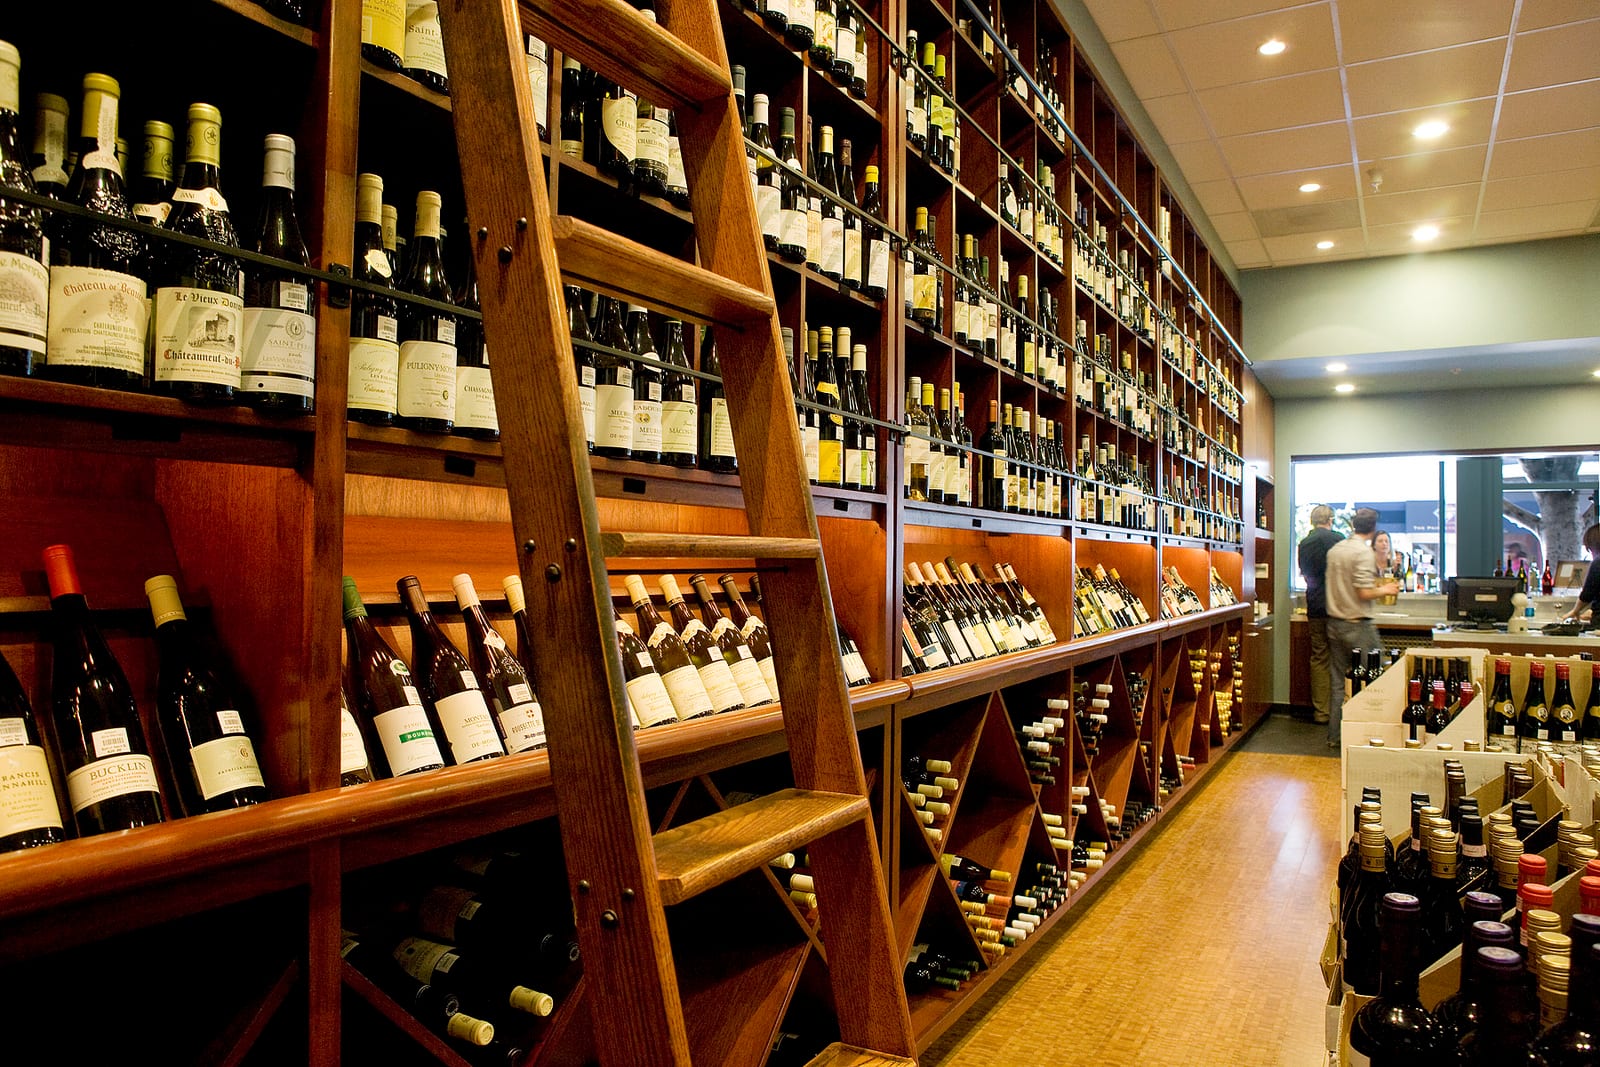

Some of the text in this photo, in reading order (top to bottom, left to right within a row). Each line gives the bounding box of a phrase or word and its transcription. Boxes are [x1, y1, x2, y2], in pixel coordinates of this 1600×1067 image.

[175, 291, 188, 302] Le
[191, 292, 219, 305] Vieux
[89, 762, 147, 780] BUCKLIN
